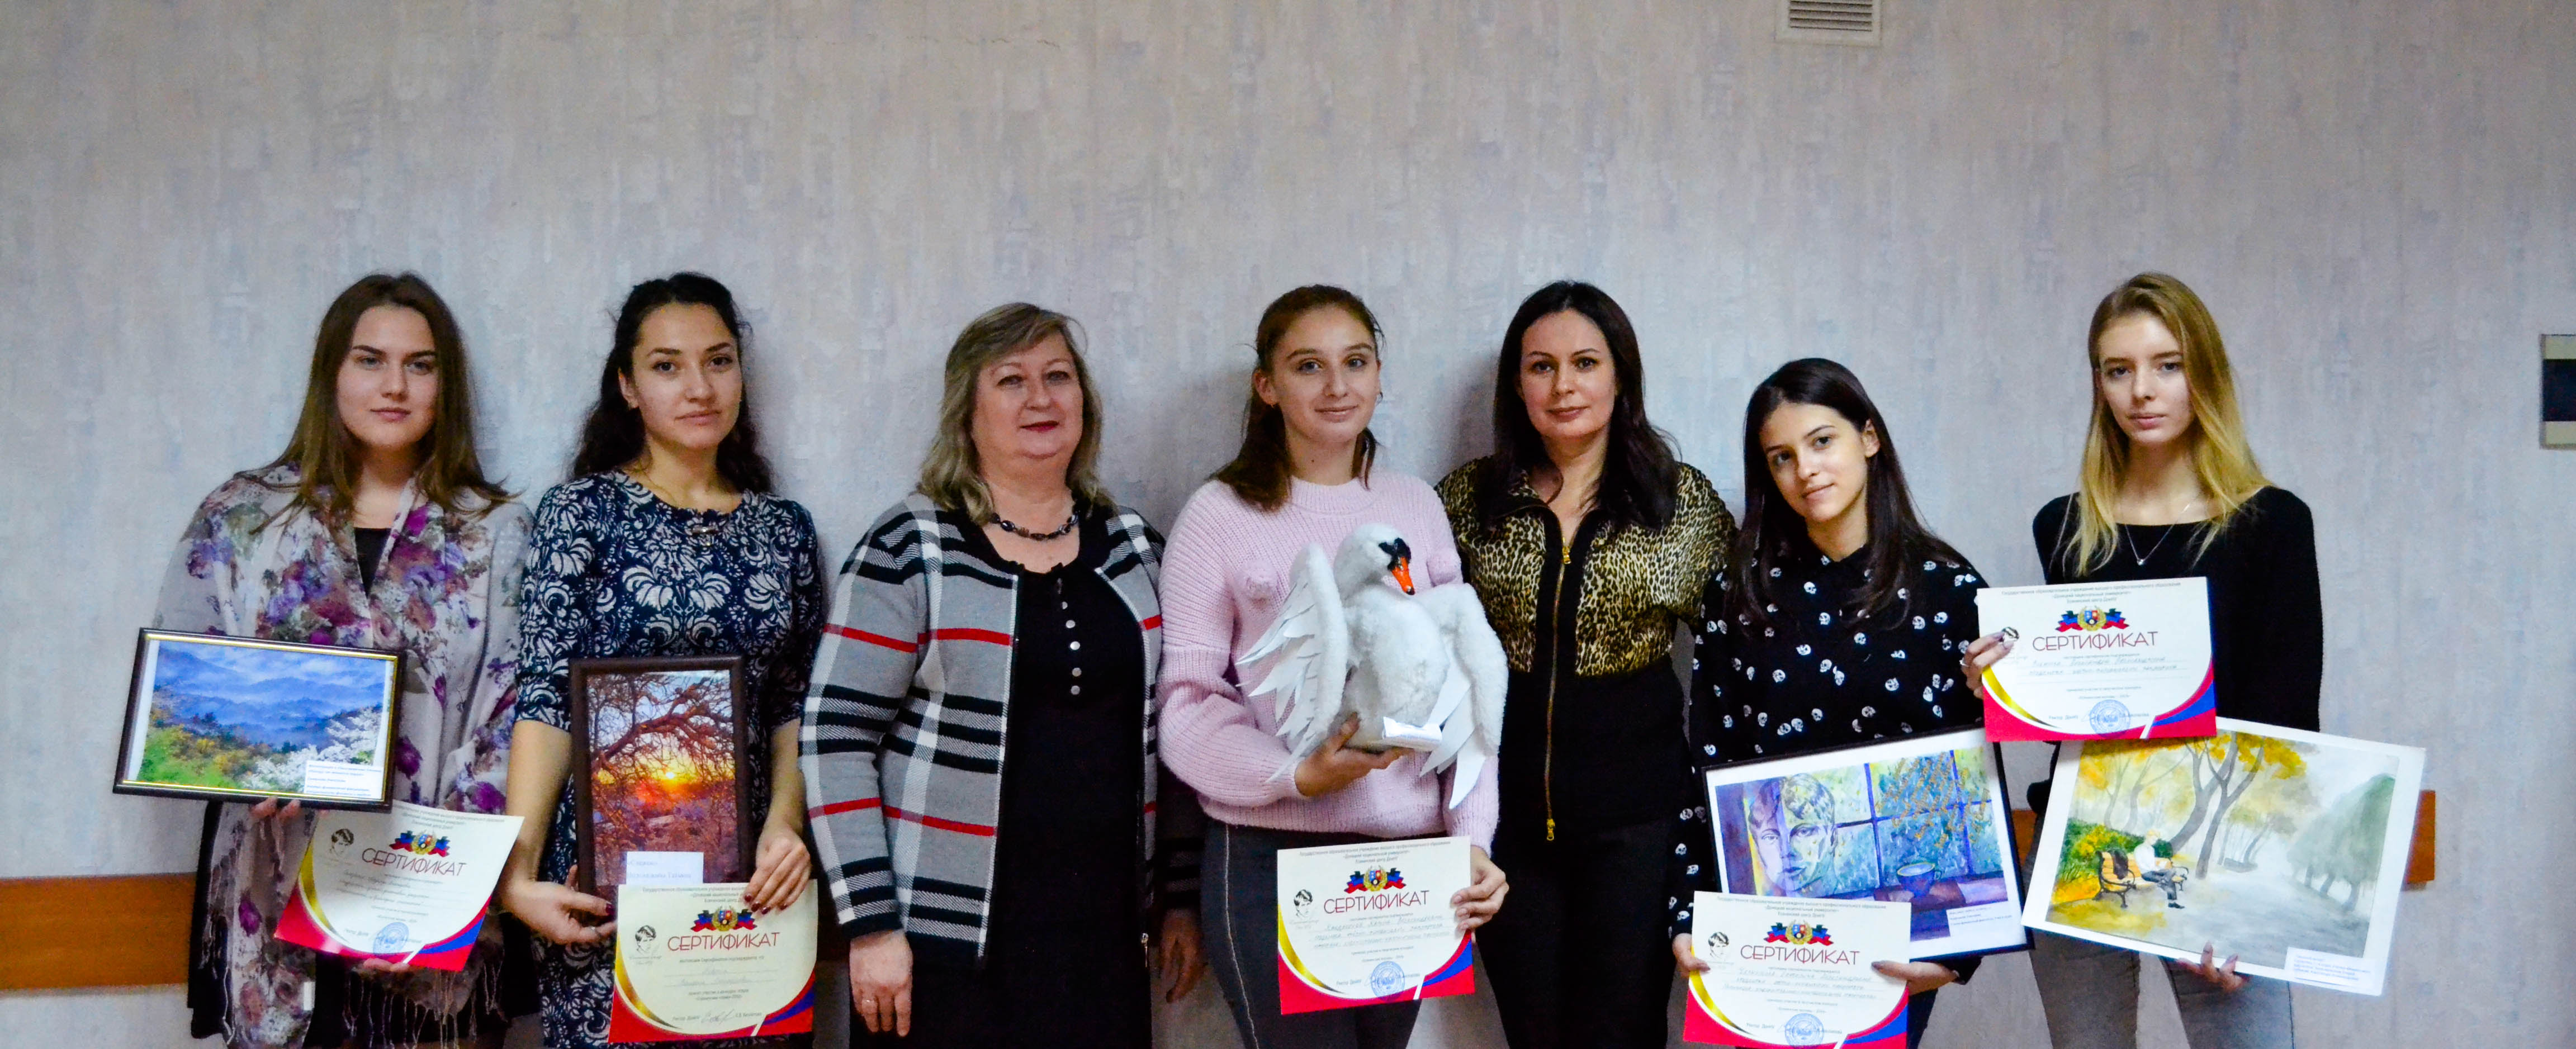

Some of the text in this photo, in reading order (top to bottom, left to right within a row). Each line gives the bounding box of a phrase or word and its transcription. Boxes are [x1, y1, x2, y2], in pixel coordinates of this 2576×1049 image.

[2032, 631, 2159, 652] СЕРТИФИКАТ
[362, 847, 467, 876] СЕРТИФИКАТ
[1323, 890, 1430, 914] СЕРТИФИКАТ
[667, 932, 780, 951] СЕРТИФИКАТ
[1740, 944, 1861, 966] СЕРТИФИКАТ
